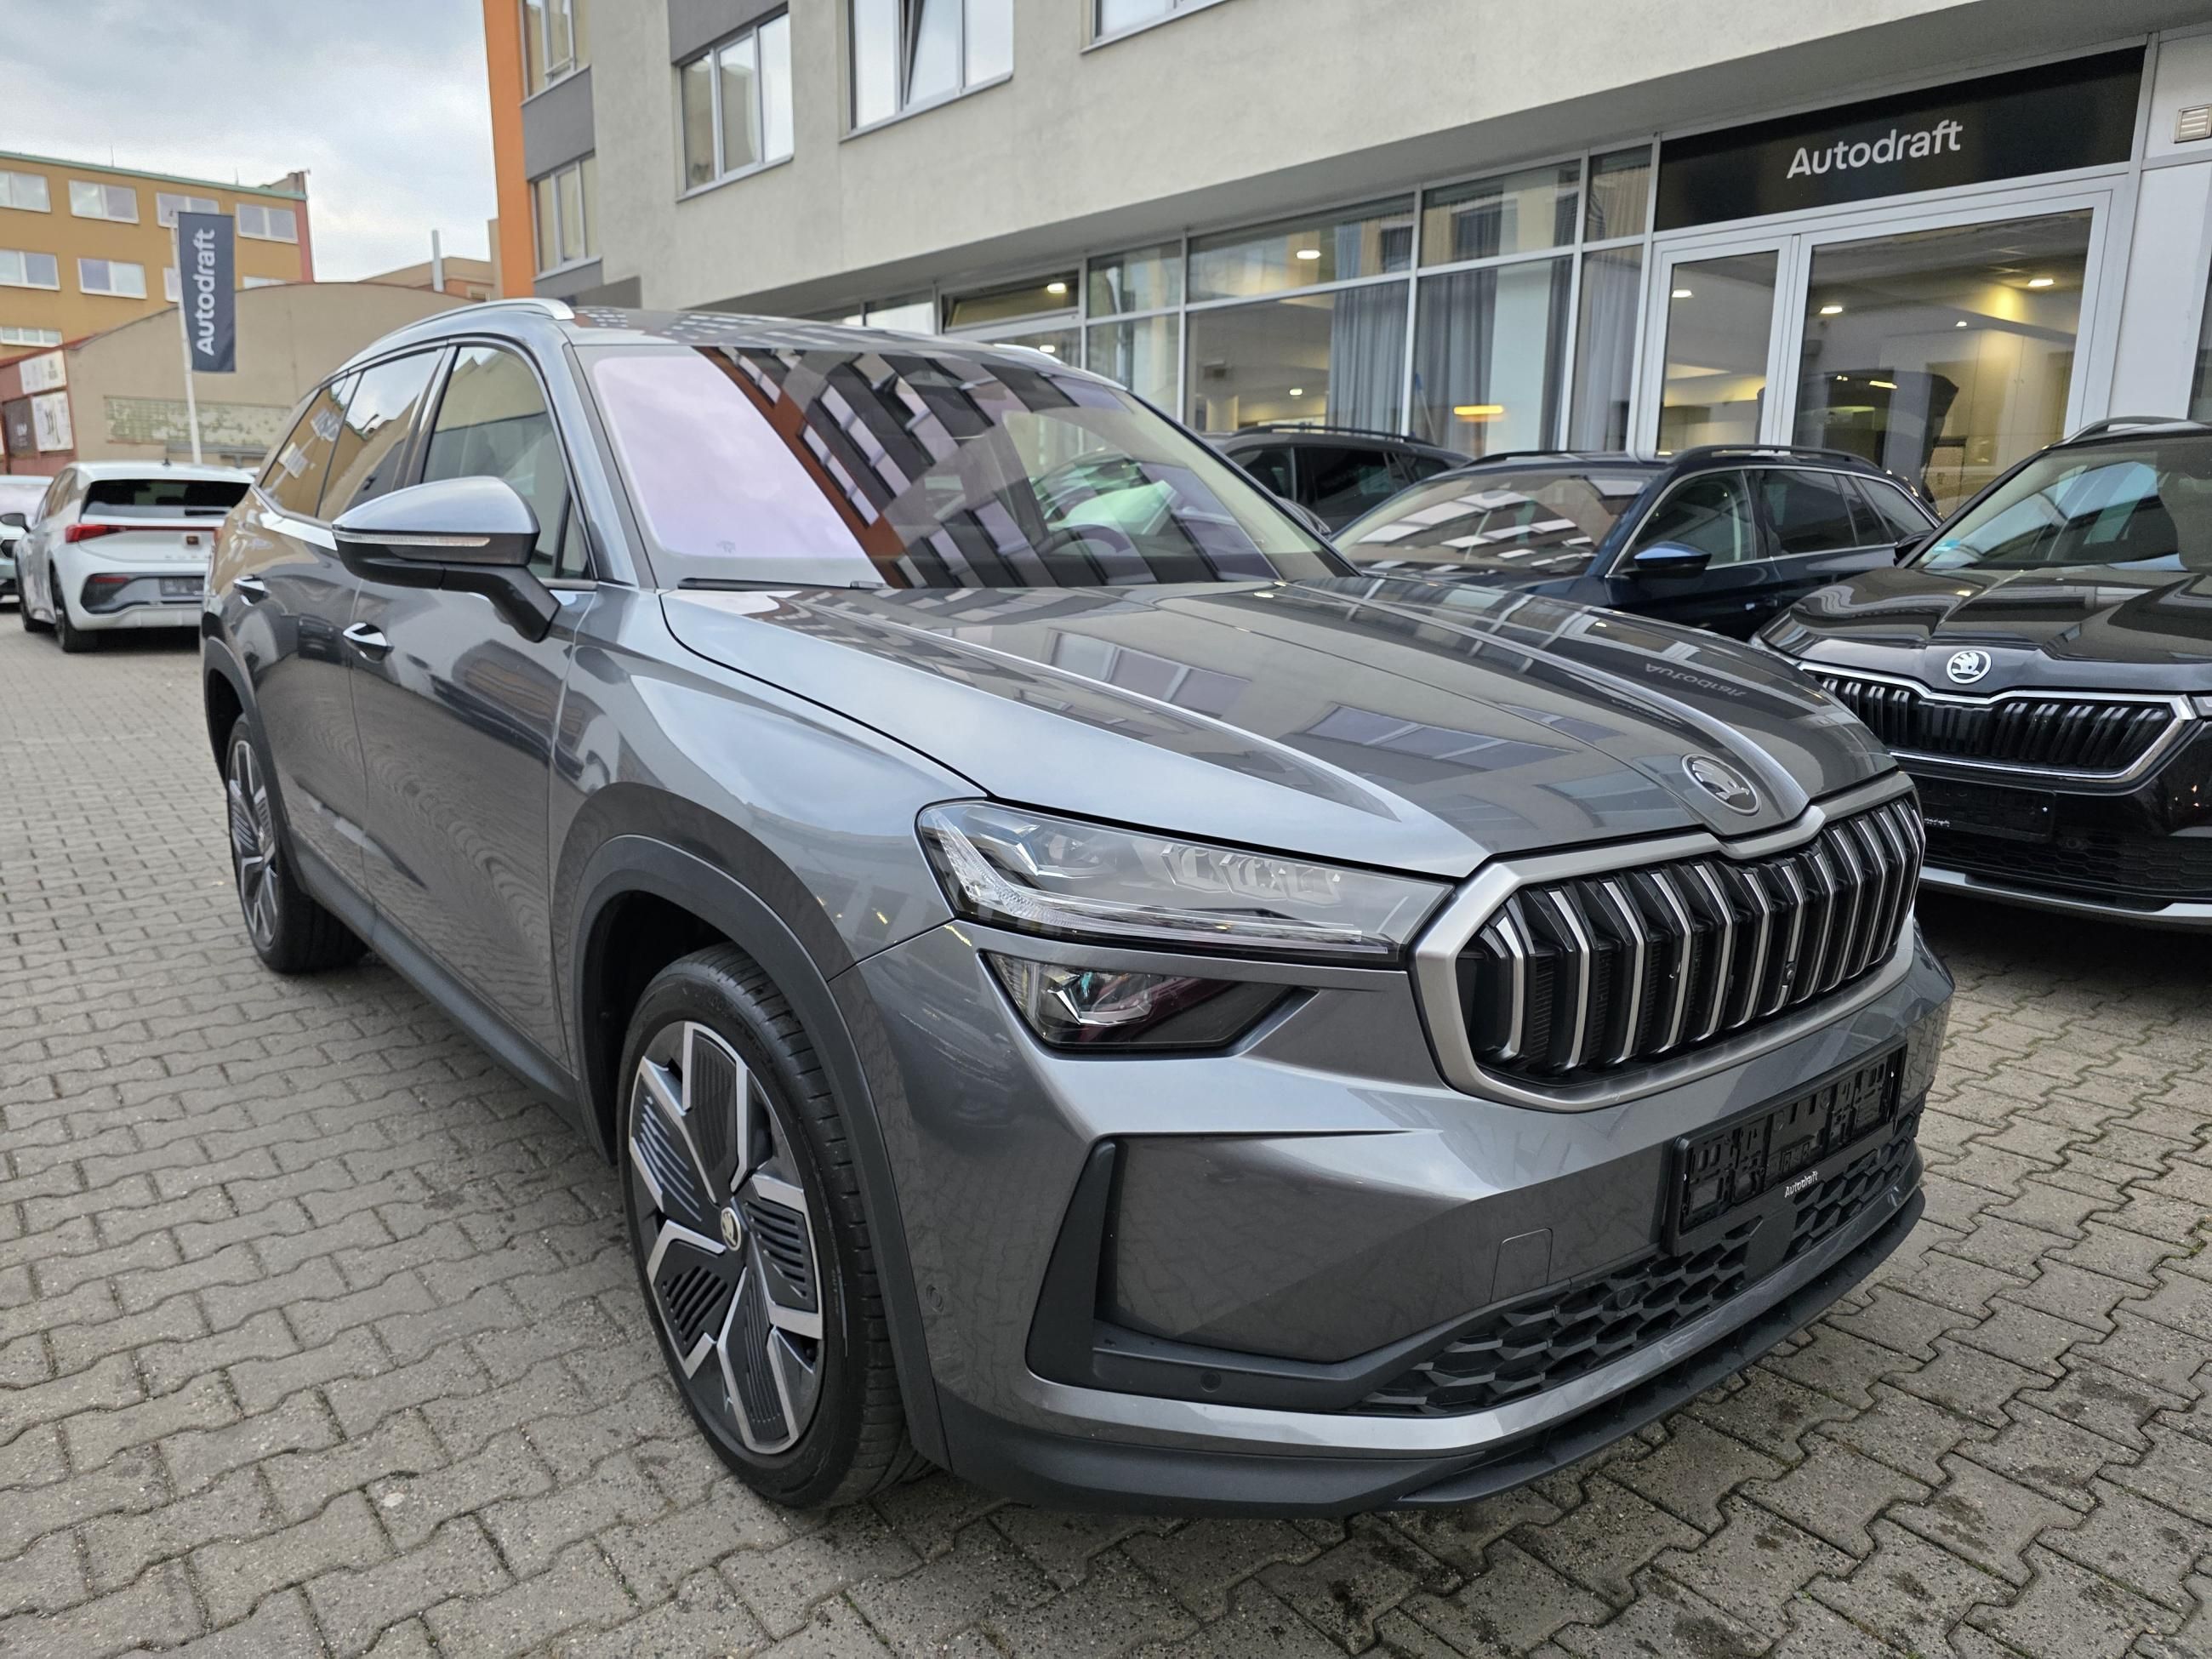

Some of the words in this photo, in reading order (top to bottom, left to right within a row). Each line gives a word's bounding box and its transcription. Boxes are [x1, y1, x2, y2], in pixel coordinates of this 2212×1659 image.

[1787, 119, 1963, 180] Autodraft
[192, 227, 216, 356] Autodraft
[1784, 1171, 1818, 1199] Autodraft
